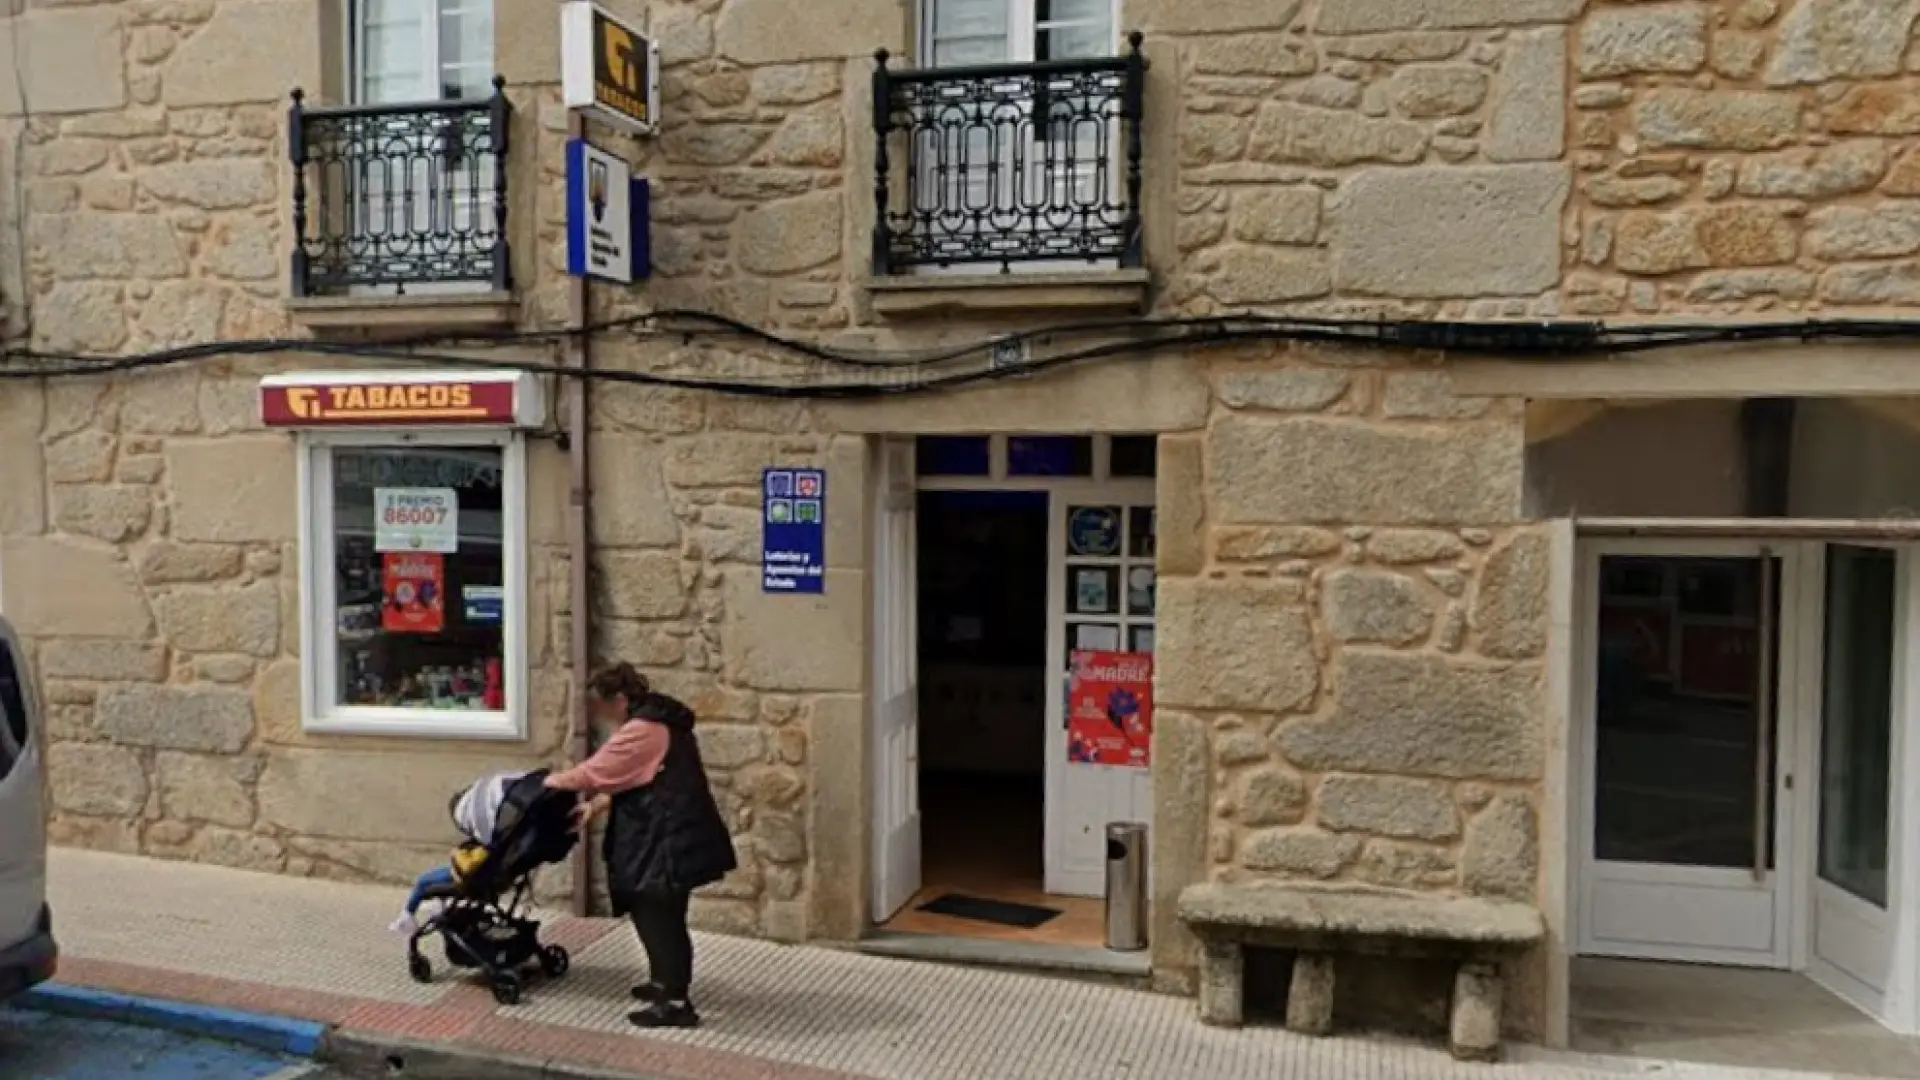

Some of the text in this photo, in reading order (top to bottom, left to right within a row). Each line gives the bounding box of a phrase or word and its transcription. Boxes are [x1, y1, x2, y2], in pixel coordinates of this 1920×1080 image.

[329, 384, 471, 408] TABACOS
[384, 507, 449, 525] 86007
[1093, 665, 1148, 682] MADRE
